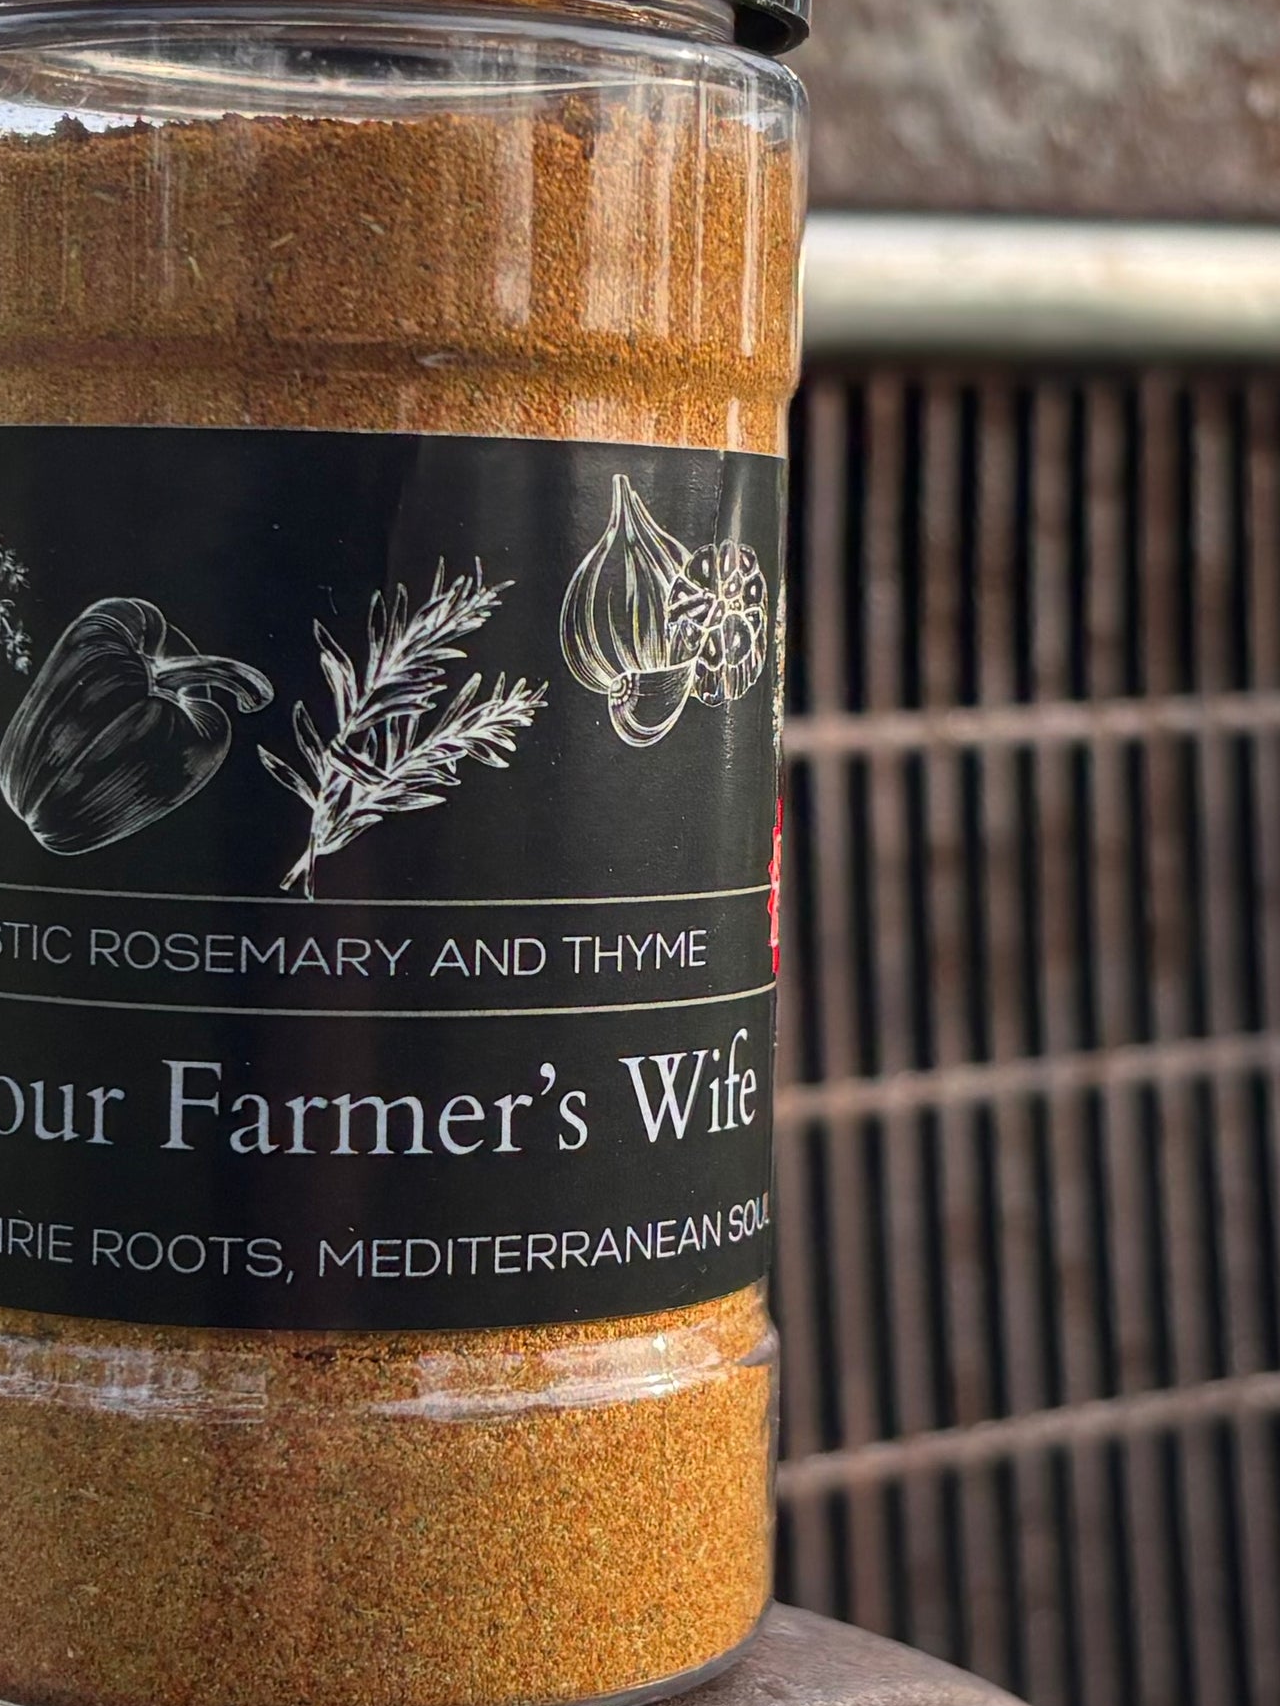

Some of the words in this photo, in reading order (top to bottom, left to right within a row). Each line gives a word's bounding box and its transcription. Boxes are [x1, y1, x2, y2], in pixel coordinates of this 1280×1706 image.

[90, 928, 413, 977] ROSEMARY
[429, 936, 547, 978] AND
[561, 928, 708, 975] THYME
[617, 1026, 758, 1145] Wife
[90, 1228, 295, 1285] ROOTS,
[317, 1209, 722, 1279] MEDITERRANEAN
